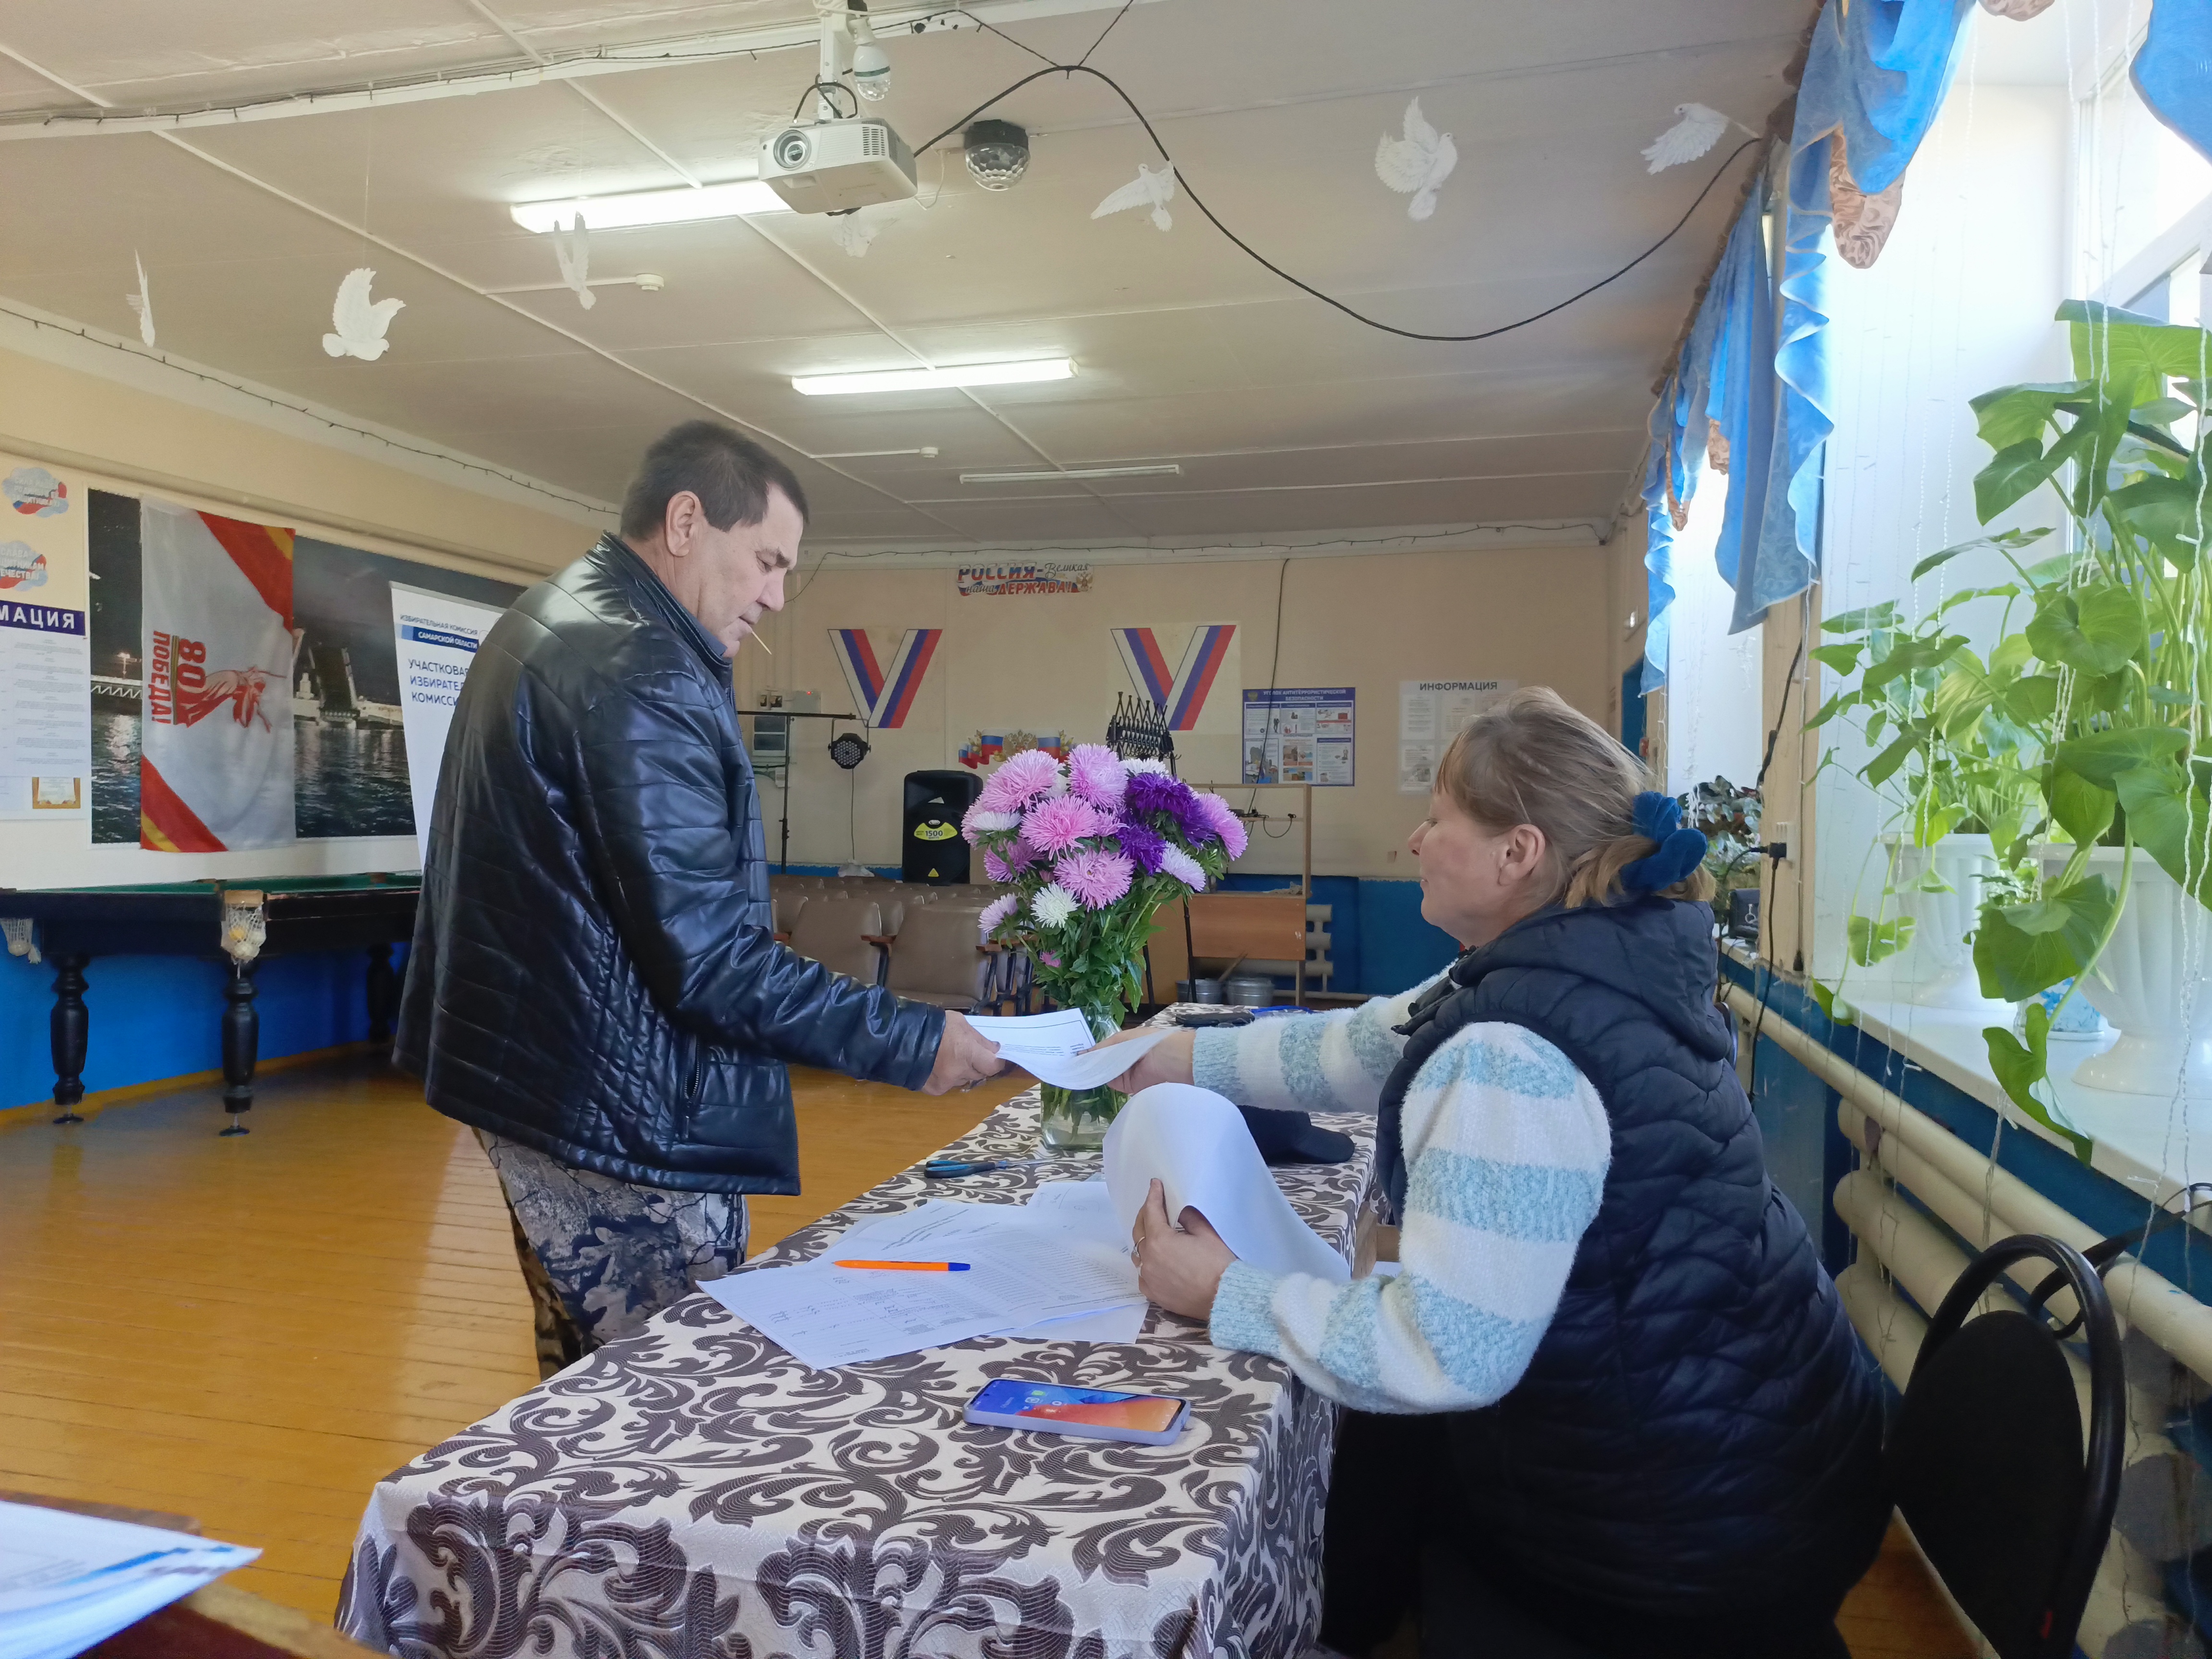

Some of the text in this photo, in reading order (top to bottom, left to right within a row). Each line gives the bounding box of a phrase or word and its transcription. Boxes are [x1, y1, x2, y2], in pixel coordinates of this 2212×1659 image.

[1044, 563, 1091, 579] Великая
[966, 581, 1072, 595] наша ДЕРЖАВА!
[0, 604, 74, 629] МАЦИЯ
[400, 614, 478, 636] ИЗБИРАТЕЛЬНАЯ КОМИССИЯ
[418, 631, 478, 649] САМАРСКОЙ ОБЛАСТИ
[178, 638, 206, 688] 80
[148, 630, 172, 724] ПОБЕДА!
[1419, 682, 1498, 692] ИНФОРМАЦИЯ
